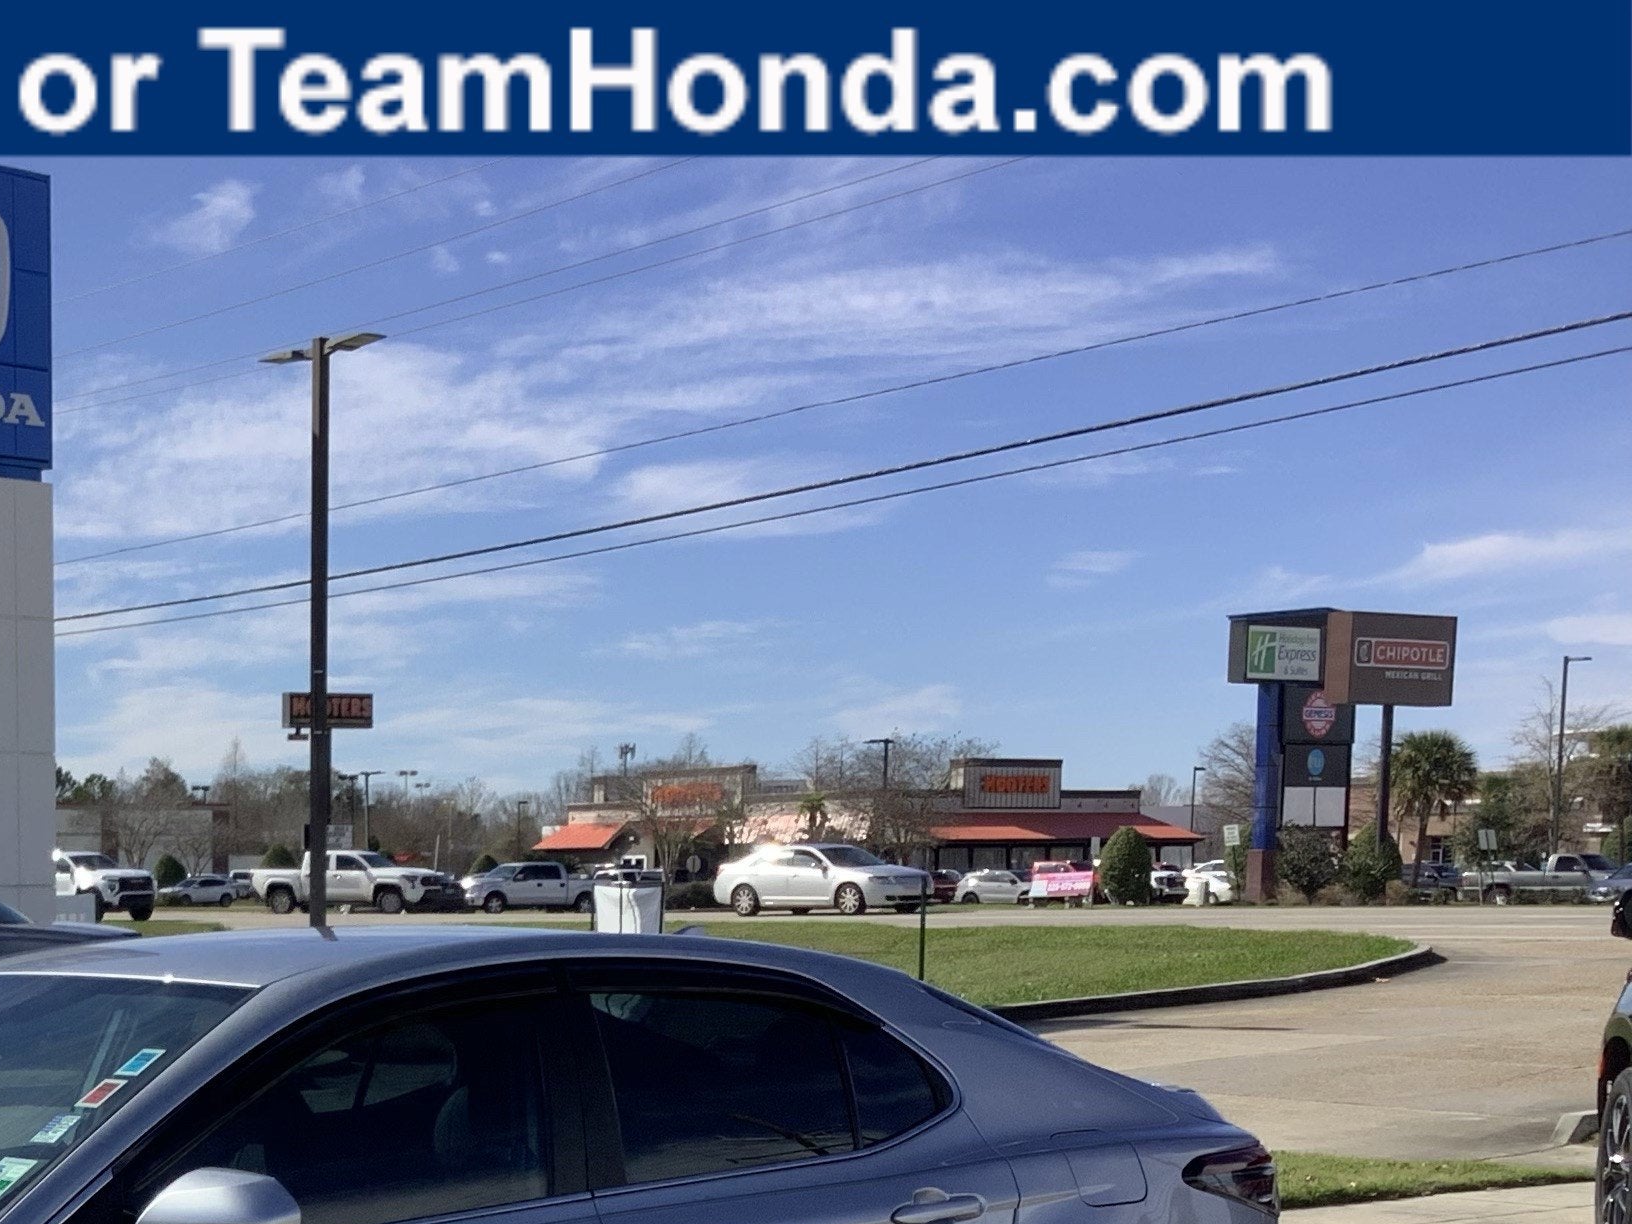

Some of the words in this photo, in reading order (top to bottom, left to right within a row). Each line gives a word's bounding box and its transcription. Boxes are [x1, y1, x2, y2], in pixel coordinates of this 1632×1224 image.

[1278, 645, 1317, 663] Express
[1376, 645, 1445, 663] CHIPOTLE
[1385, 671, 1420, 680] MEXICAN
[1421, 672, 1443, 681] GRILL
[292, 697, 372, 717] HTERS
